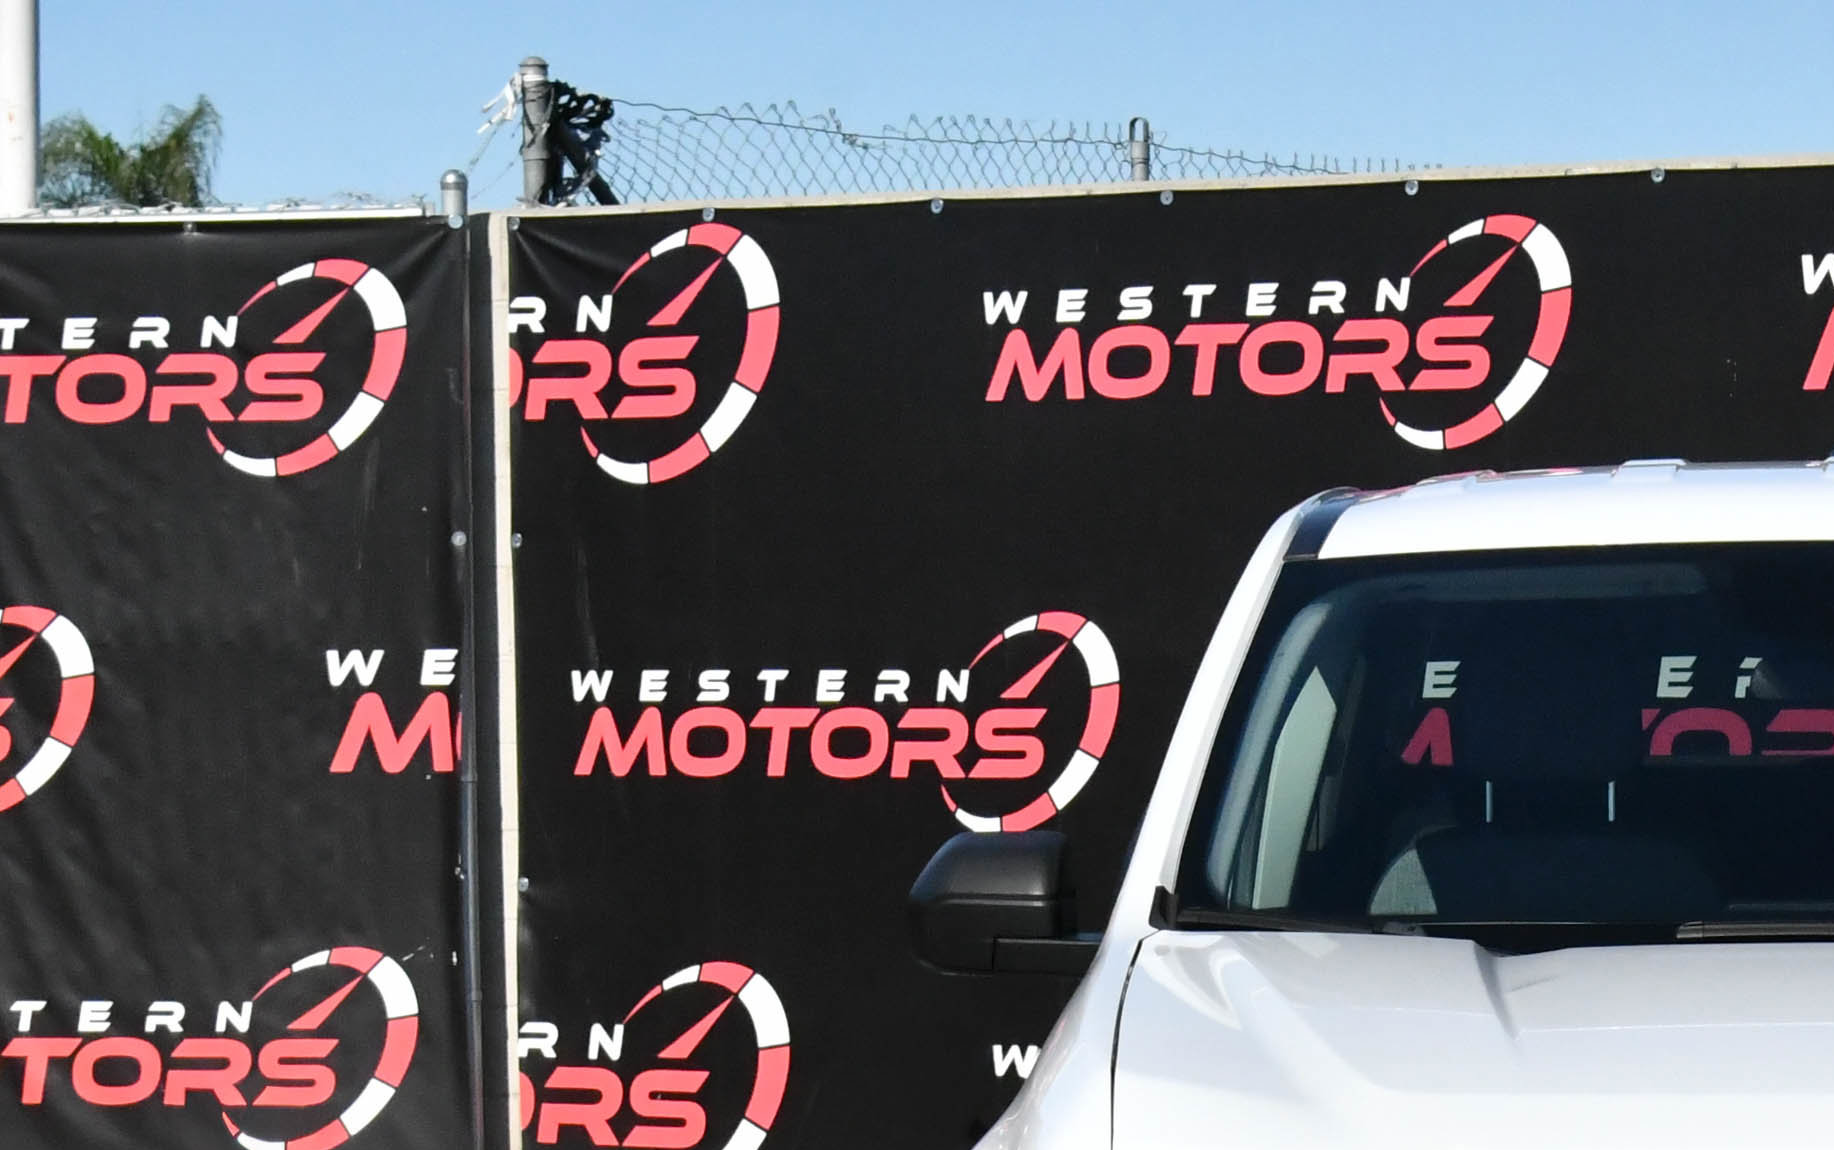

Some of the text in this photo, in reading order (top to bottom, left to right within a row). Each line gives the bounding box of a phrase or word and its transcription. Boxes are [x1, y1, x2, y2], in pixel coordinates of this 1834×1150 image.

[983, 277, 1411, 325] WESTERN
[985, 315, 1495, 402] MOTORS
[572, 669, 970, 702] WESTERN
[573, 706, 1048, 779] MOTORS
